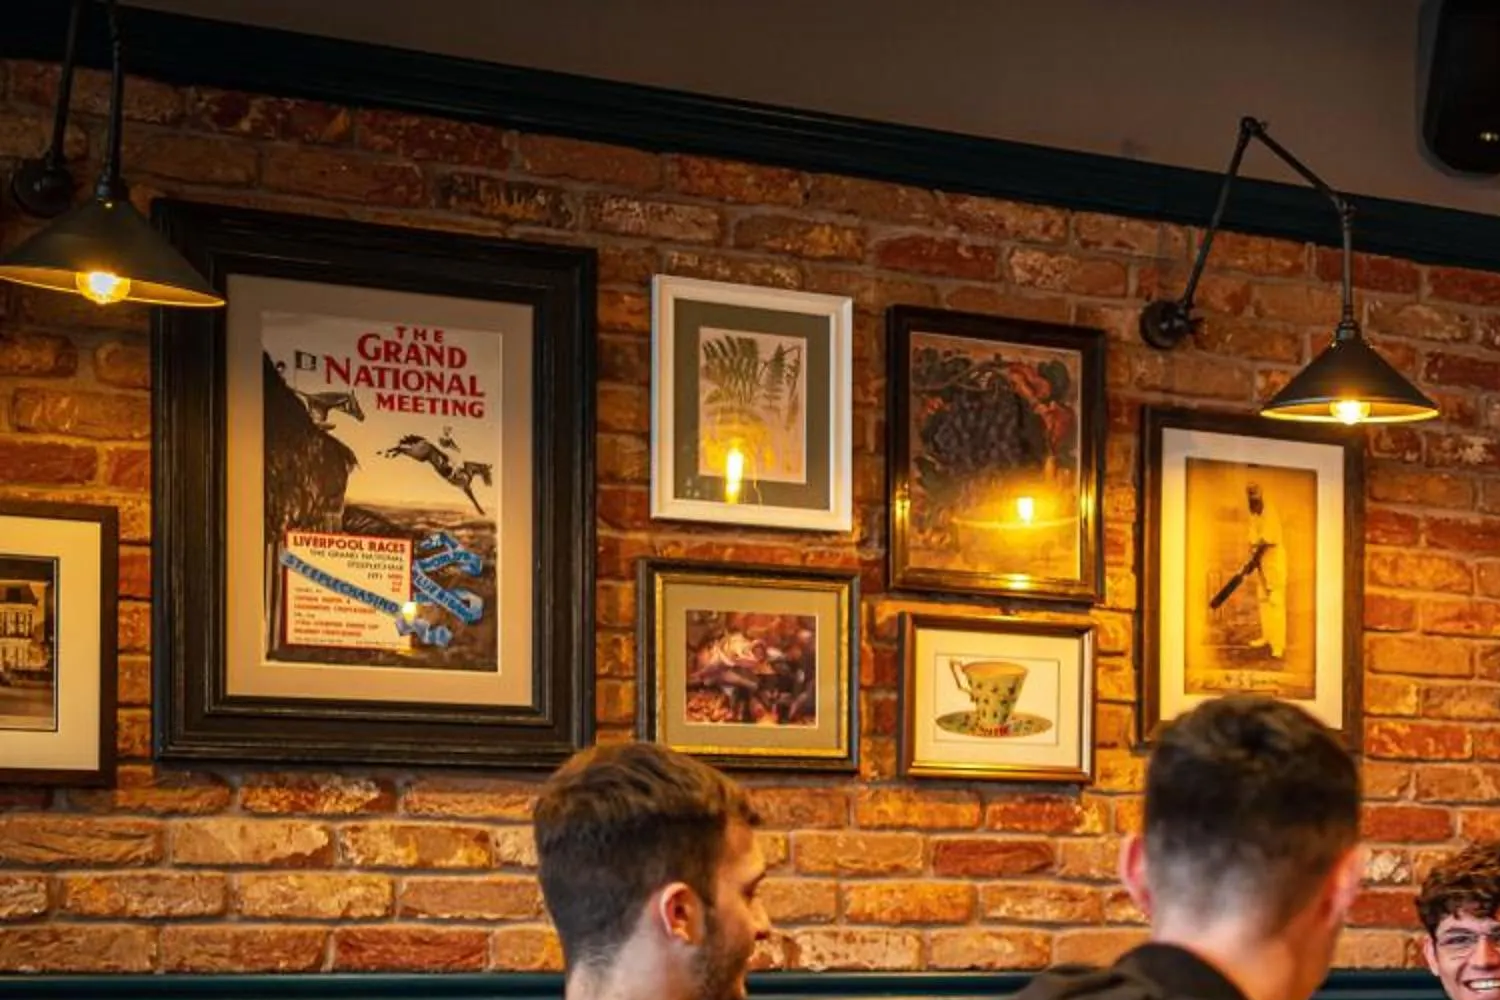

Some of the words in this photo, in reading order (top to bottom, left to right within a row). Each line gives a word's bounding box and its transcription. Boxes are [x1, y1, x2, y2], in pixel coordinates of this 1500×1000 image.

[395, 326, 444, 342] THE
[357, 333, 467, 369] GRAND
[323, 354, 485, 398] NATIONAL
[376, 391, 485, 419] MEETING
[293, 535, 364, 551] LIVERPOOL
[368, 540, 406, 553] RACES
